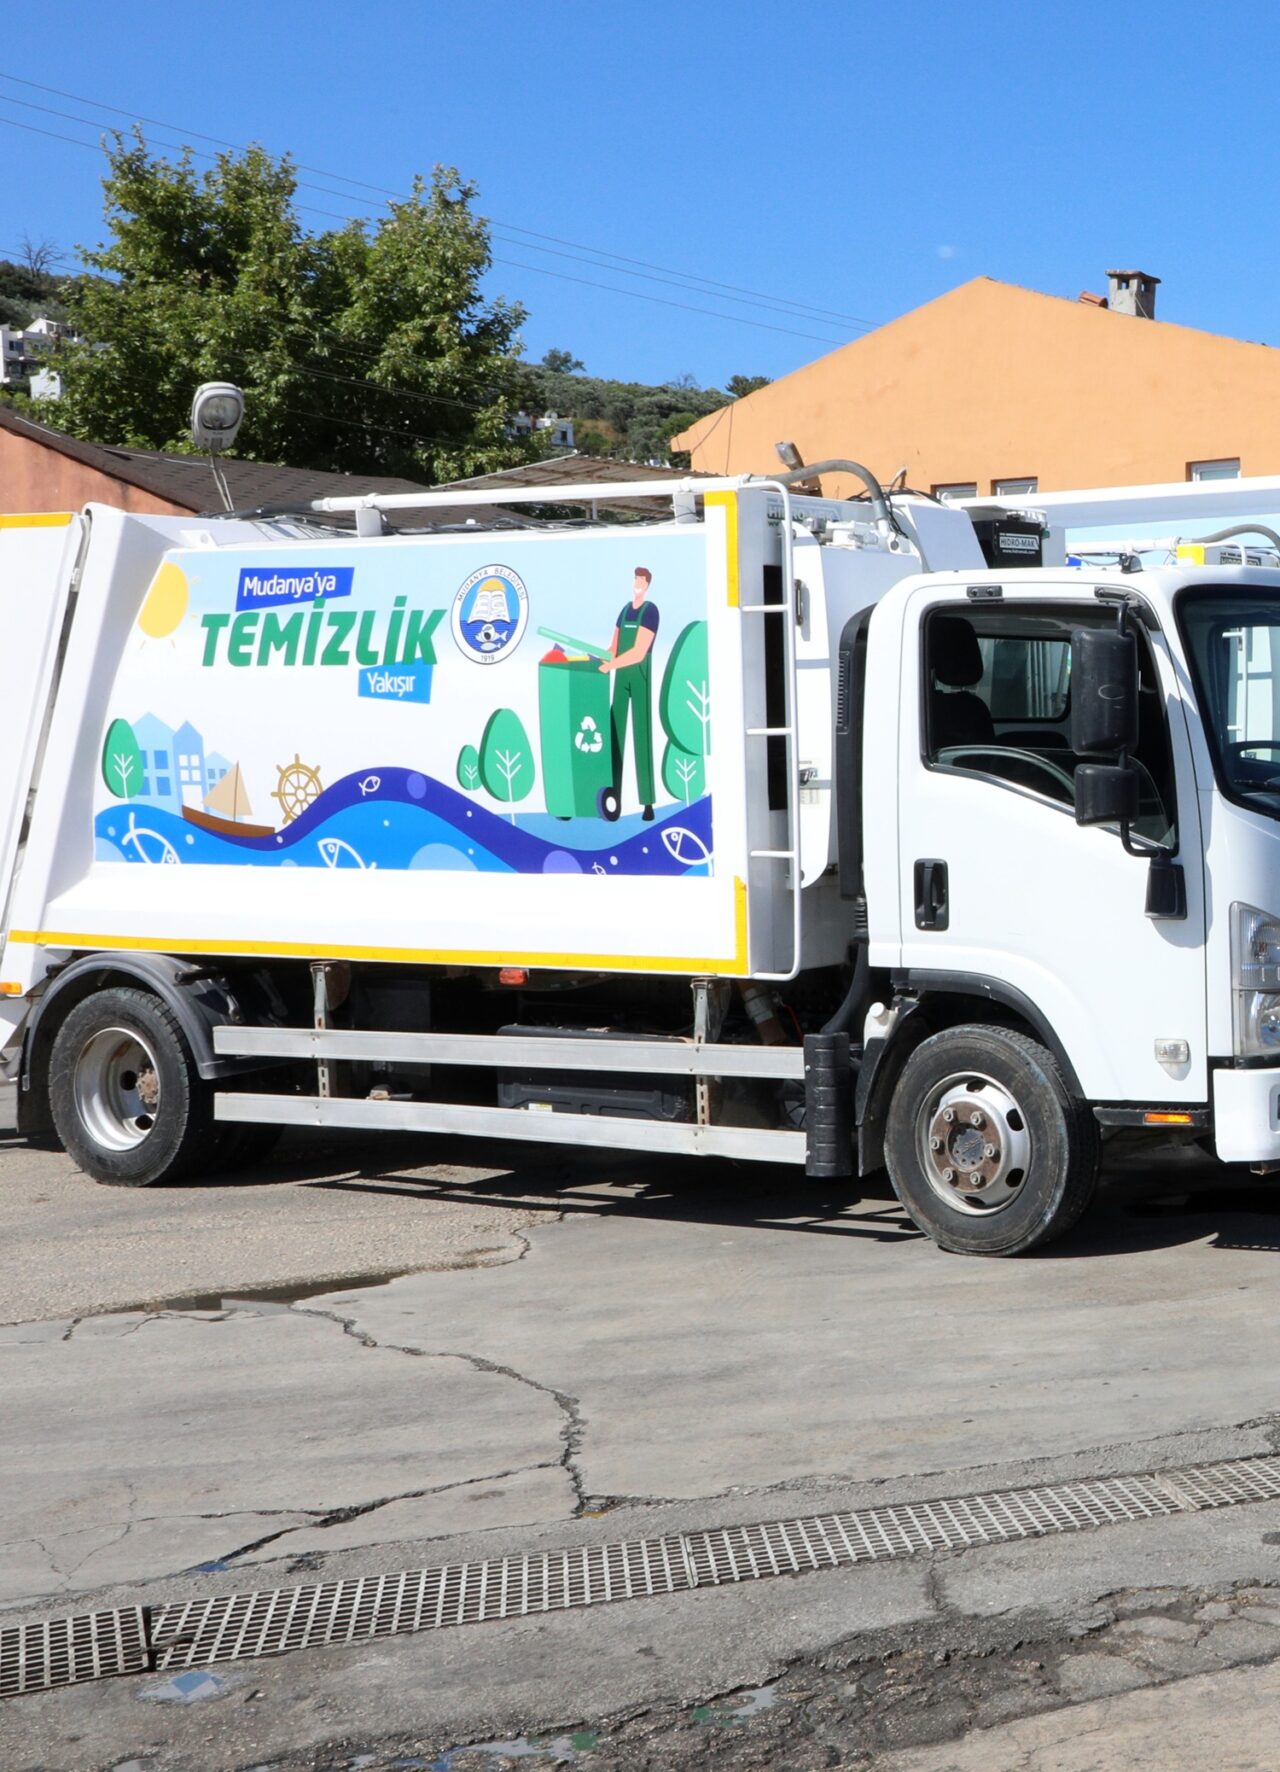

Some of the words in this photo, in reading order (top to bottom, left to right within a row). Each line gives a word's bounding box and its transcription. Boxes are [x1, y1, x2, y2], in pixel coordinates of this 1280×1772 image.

[243, 572, 337, 598] Mudanya'ya
[457, 569, 488, 601] MUDANYA
[200, 595, 448, 667] TEMİZLİK
[366, 672, 416, 697] Yakışır
